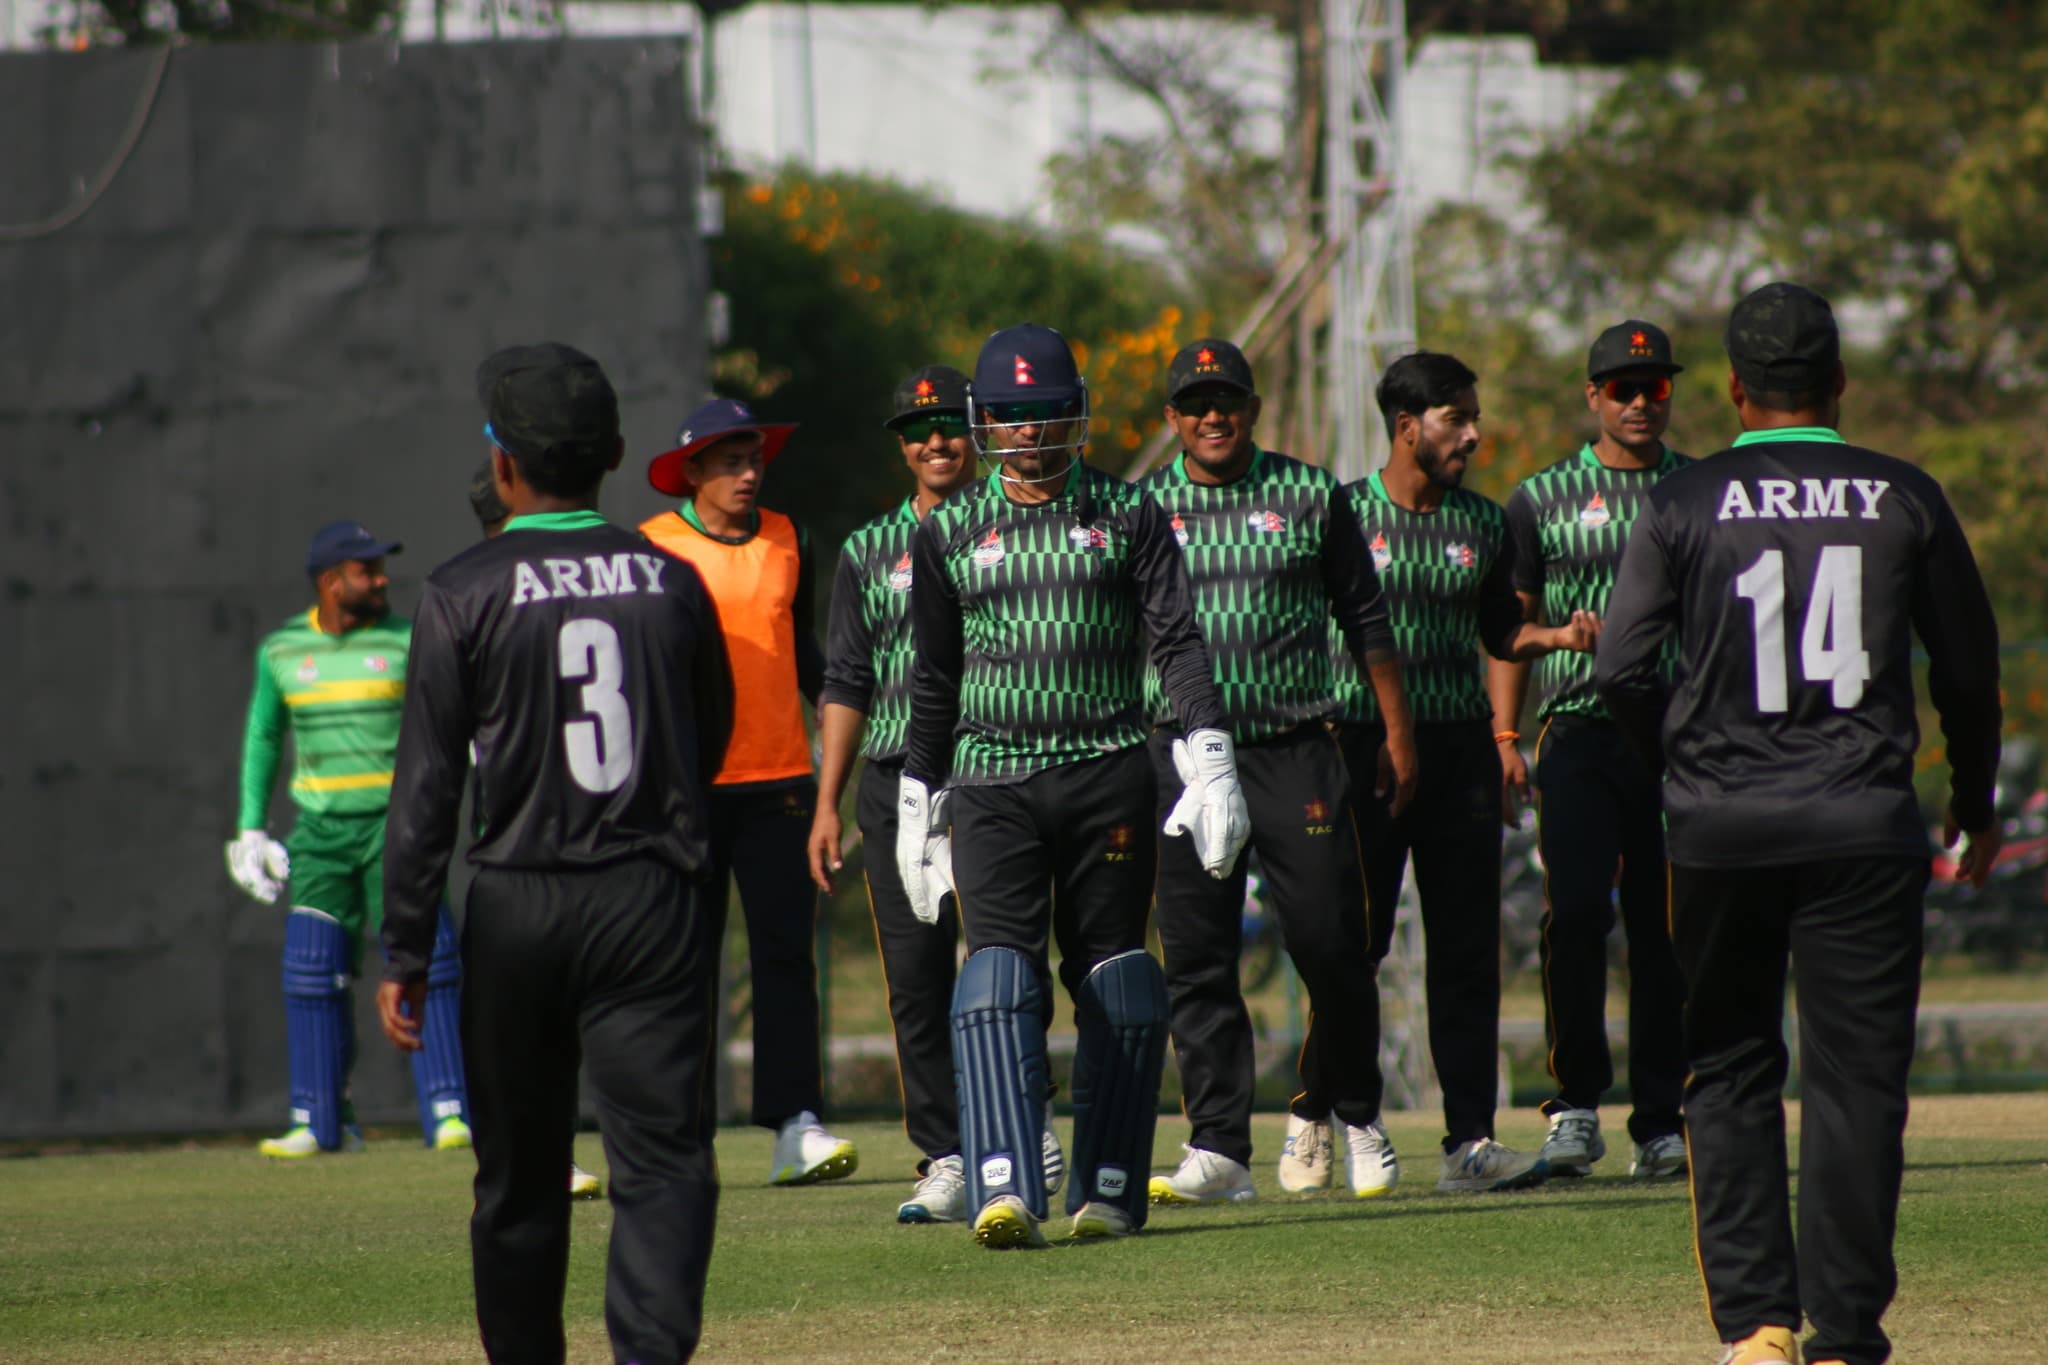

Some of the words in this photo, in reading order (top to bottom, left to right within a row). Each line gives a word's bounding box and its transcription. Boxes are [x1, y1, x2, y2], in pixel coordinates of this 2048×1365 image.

[1718, 478, 1890, 521] ARMY
[512, 553, 666, 606] ARMY
[1736, 545, 1871, 712] 14
[558, 618, 633, 793] 3
[1304, 825, 1333, 836] TAC
[987, 1166, 1007, 1178] ZAP
[1102, 1178, 1122, 1189] ZAP
